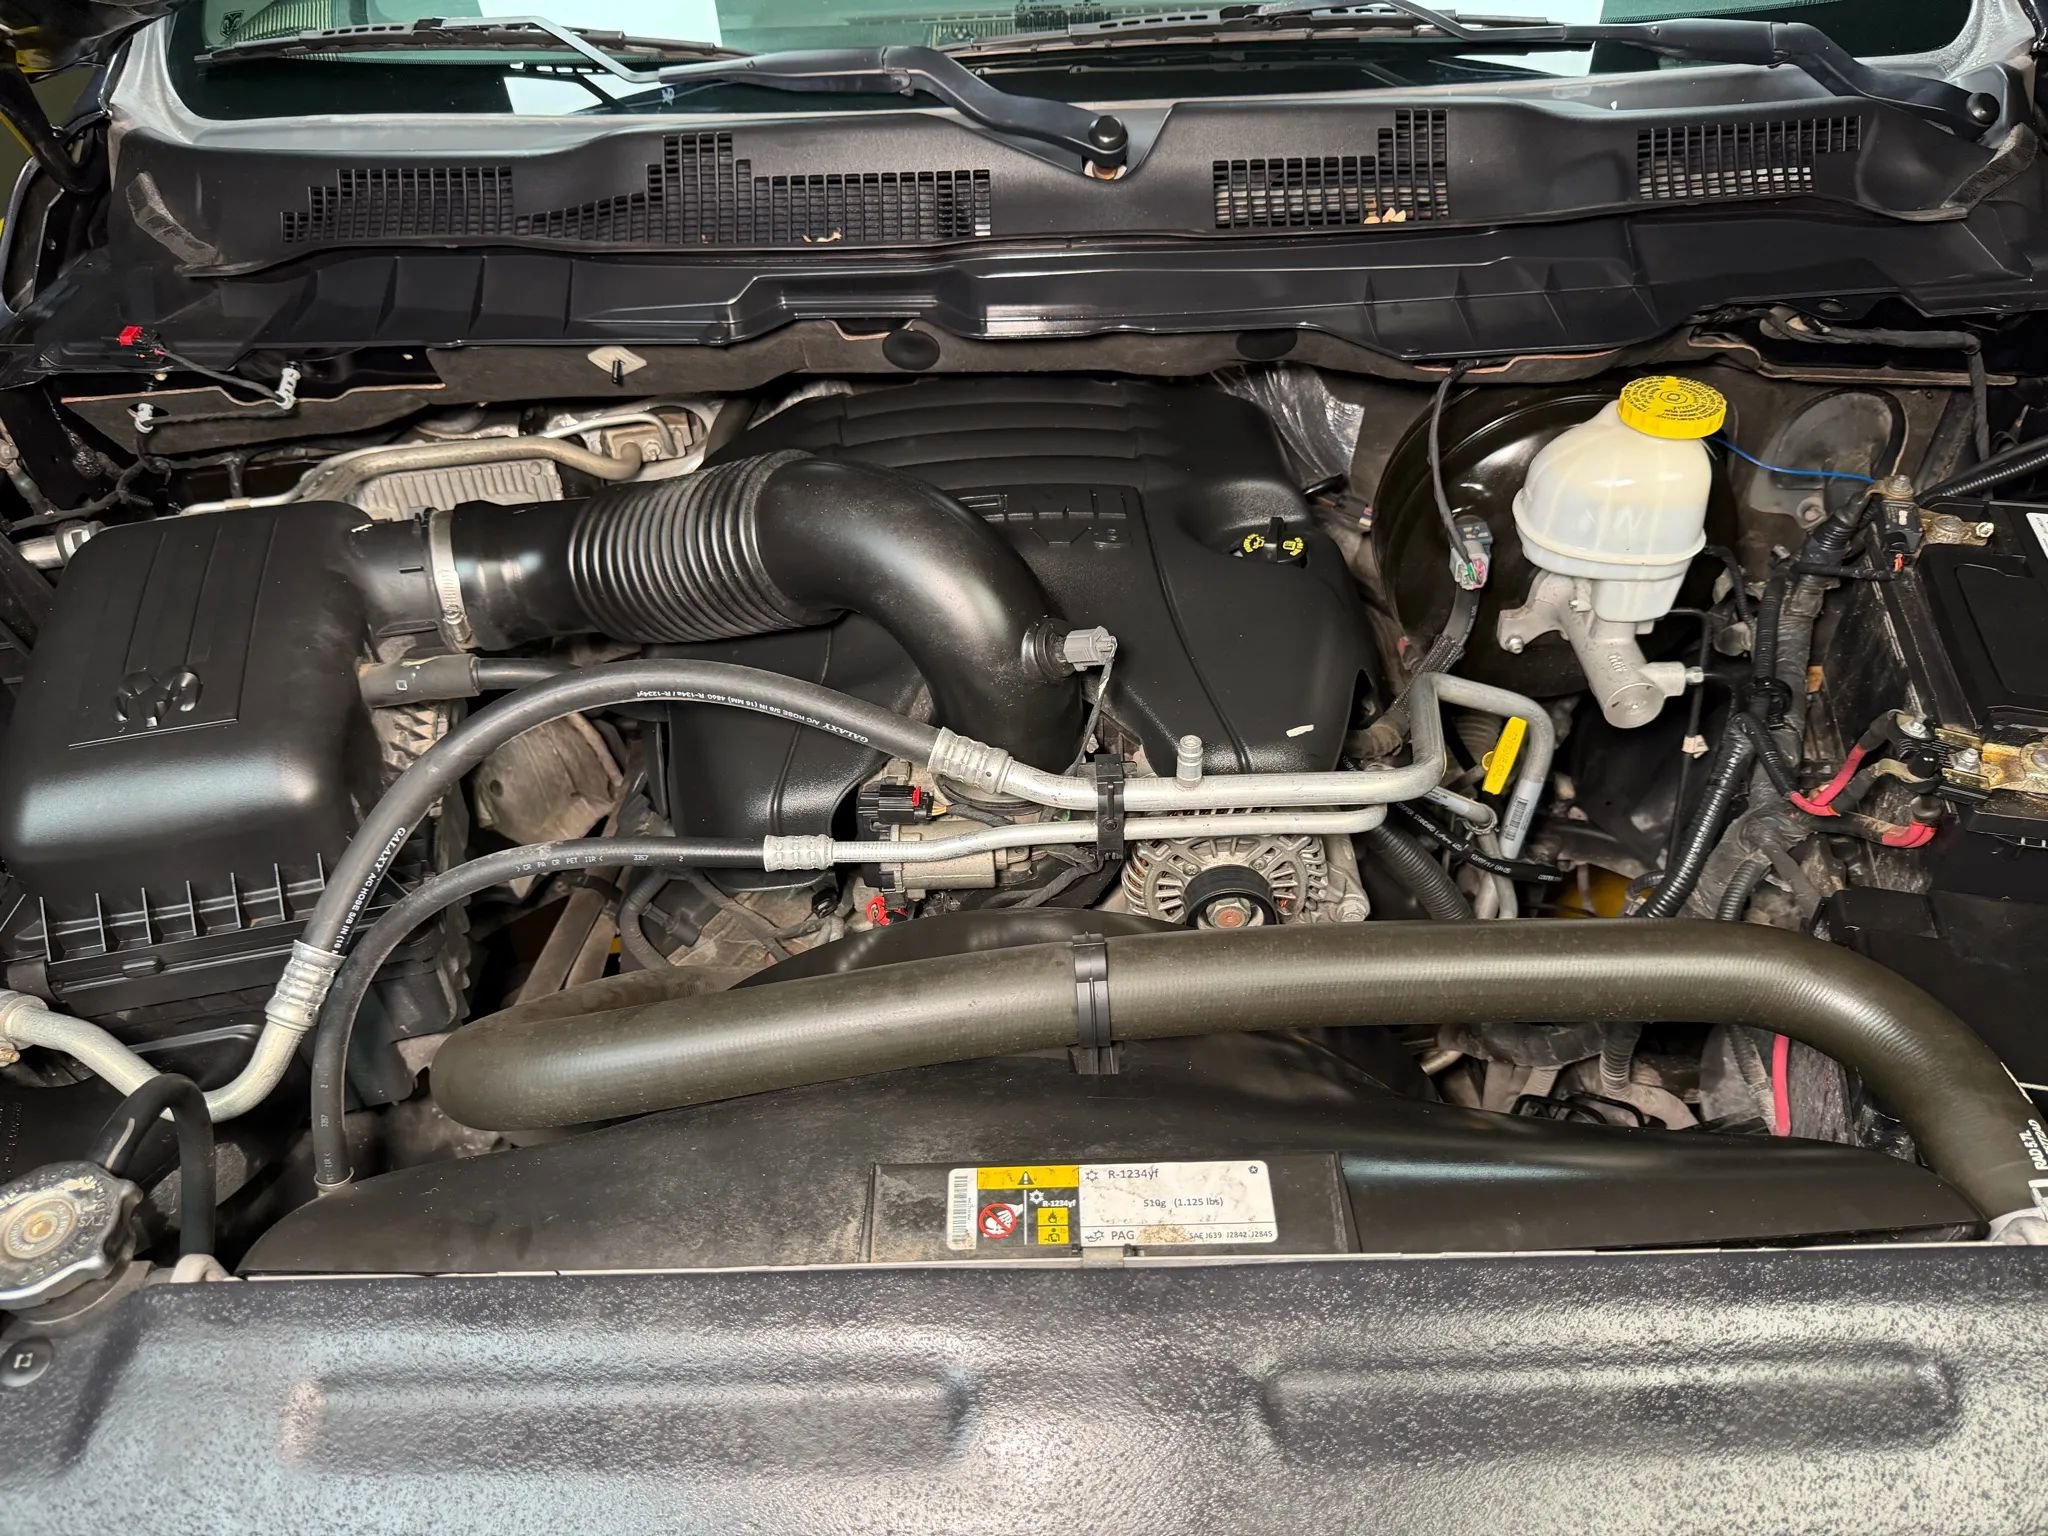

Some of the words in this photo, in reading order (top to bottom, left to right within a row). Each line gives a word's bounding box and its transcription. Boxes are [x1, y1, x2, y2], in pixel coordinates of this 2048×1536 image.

[758, 703, 768, 711] IN
[782, 709, 806, 721] HOSE
[806, 717, 821, 726] A/C
[823, 723, 869, 743] GALAXY
[373, 826, 407, 873] GALAXY
[351, 887, 369, 911] HOSE
[339, 924, 350, 935] IN
[1108, 1168, 1159, 1181] R-1234yf
[1042, 1199, 1077, 1209] R-1234yf
[1143, 1199, 1167, 1209] 510g
[1173, 1197, 1204, 1208] (1.125
[1205, 1197, 1224, 1207] lbs)
[1111, 1230, 1135, 1241] PAG
[1189, 1231, 1203, 1240] SAE
[1205, 1231, 1222, 1240] J639
